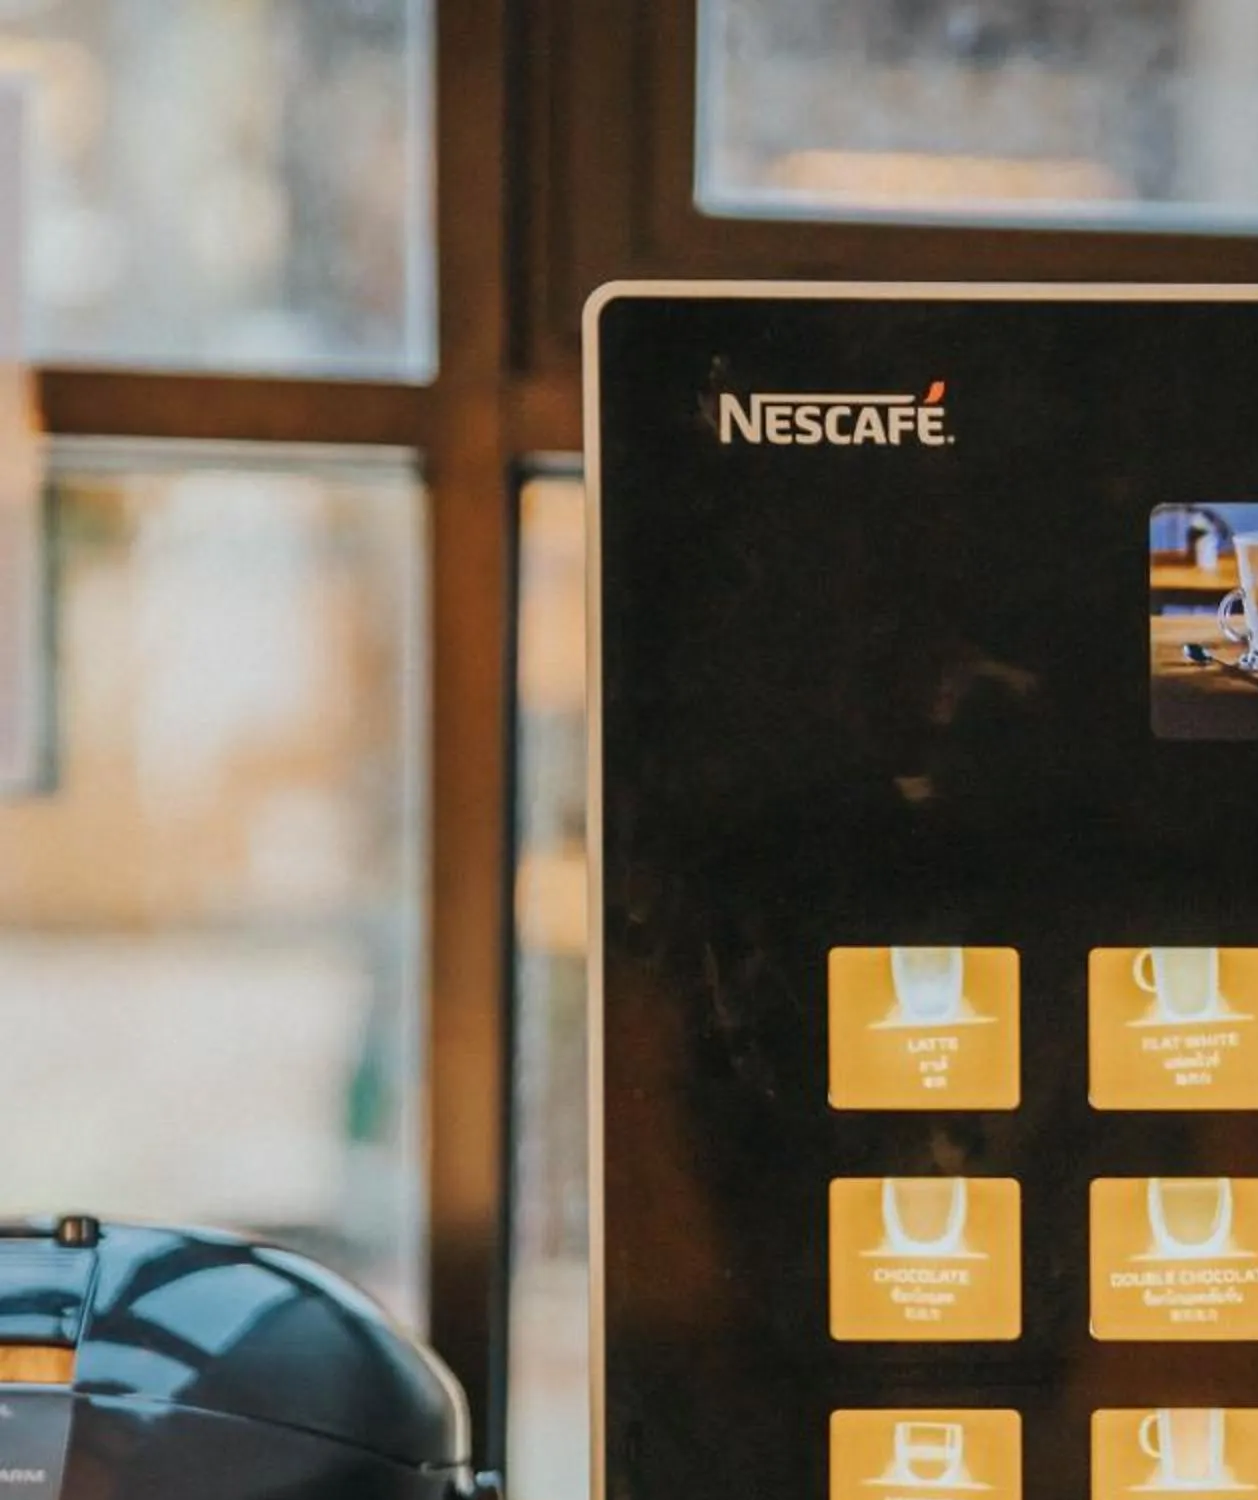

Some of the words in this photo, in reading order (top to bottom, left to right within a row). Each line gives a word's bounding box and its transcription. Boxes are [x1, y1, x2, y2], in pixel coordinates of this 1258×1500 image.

[719, 381, 955, 445] NESCAFÉ
[873, 1268, 970, 1286] CHOCOLATE
[1110, 1271, 1177, 1289] DOUBLE
